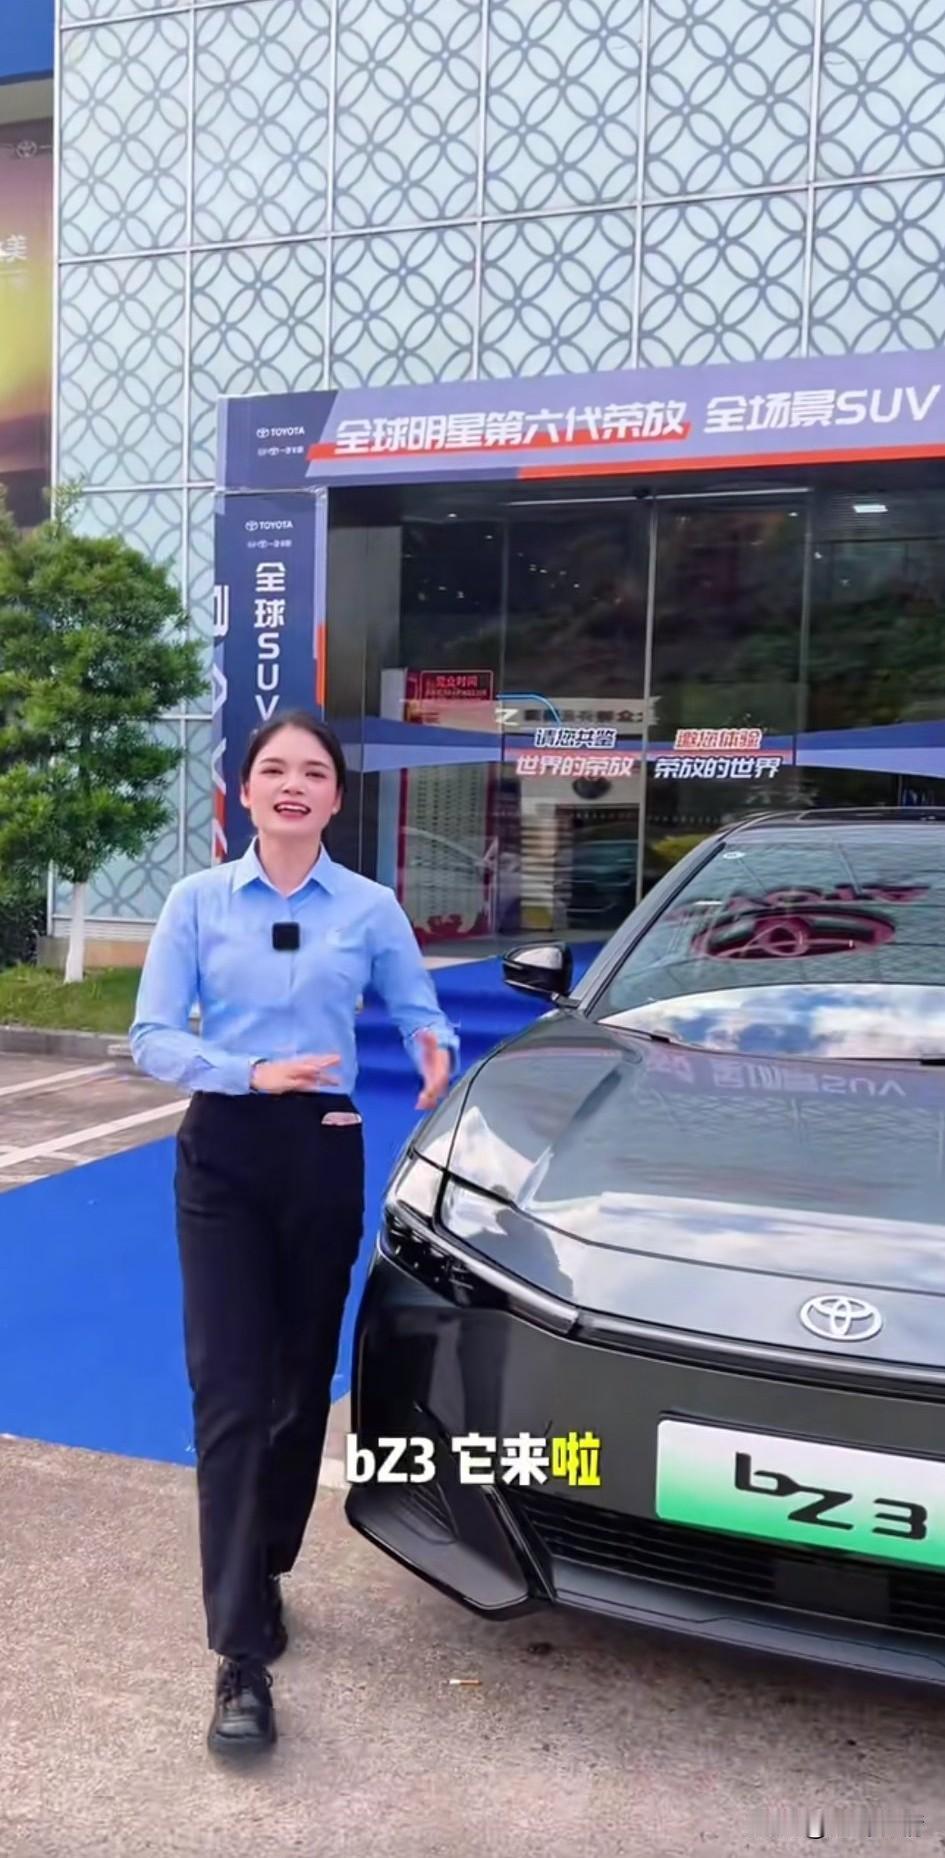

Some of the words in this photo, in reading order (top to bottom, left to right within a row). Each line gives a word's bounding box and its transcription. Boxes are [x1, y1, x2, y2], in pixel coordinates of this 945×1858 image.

[334, 400, 687, 455] 全球明星第六代荣放
[703, 384, 942, 434] 全场景SUV
[271, 426, 304, 437] TOYOTA
[259, 520, 294, 530] TOYOTA
[534, 728, 617, 749] 请您共鉴
[516, 755, 635, 777] 世界的荣放
[654, 757, 781, 779] 荣放的世界
